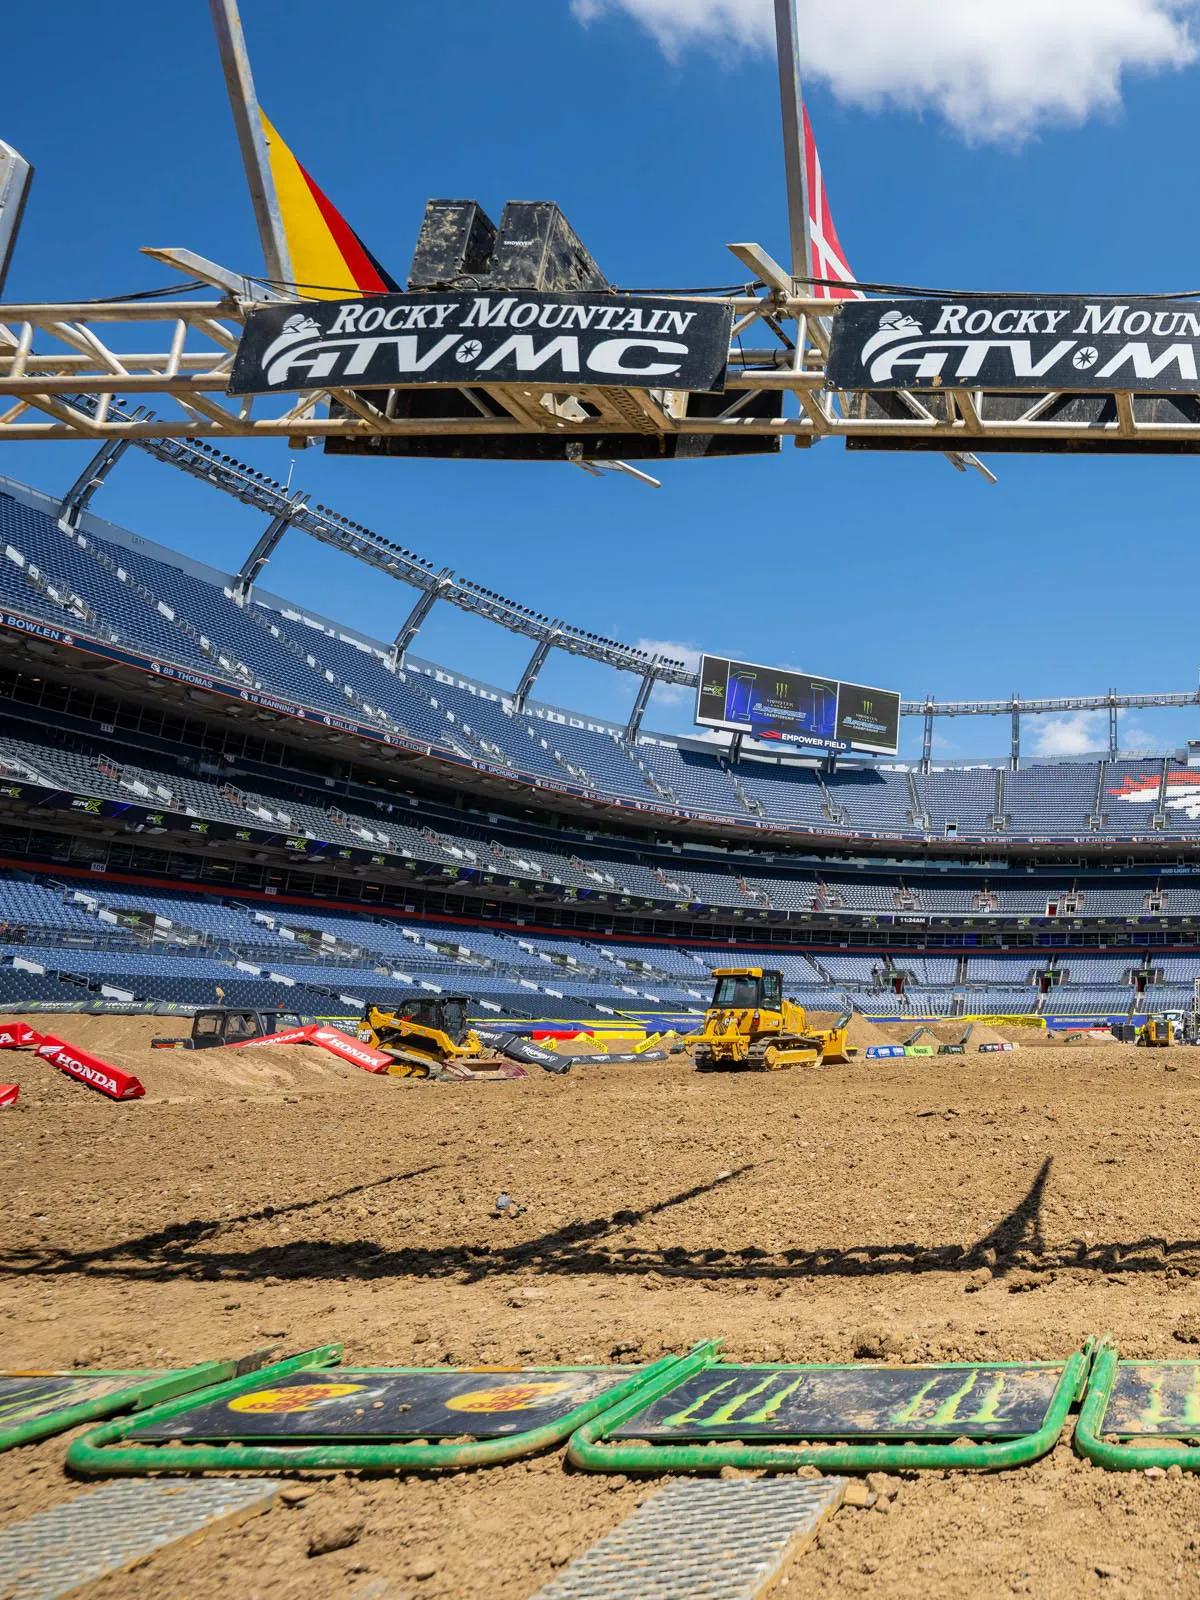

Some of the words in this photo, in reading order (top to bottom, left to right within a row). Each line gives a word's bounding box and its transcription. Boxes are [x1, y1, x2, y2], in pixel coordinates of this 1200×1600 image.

[333, 301, 460, 335] ROCKY
[462, 297, 697, 336] MOUNTAIN
[931, 305, 1069, 336] ROCKY
[7, 614, 60, 641] BOWLEN
[163, 666, 174, 676] 88
[177, 670, 214, 688] THOMAS
[260, 698, 295, 715] MANNING
[332, 719, 358, 733] MILLER
[399, 739, 429, 753] FLETCHER
[781, 733, 823, 746] EMPOWER
[824, 739, 847, 750] FIELD
[488, 766, 519, 780] UPCHURCH
[72, 800, 103, 813] SMX
[358, 1034, 369, 1042] CAT
[331, 1039, 378, 1067] HONDA
[522, 1046, 549, 1060] TRIUMPH
[55, 1052, 118, 1094] HONDA
